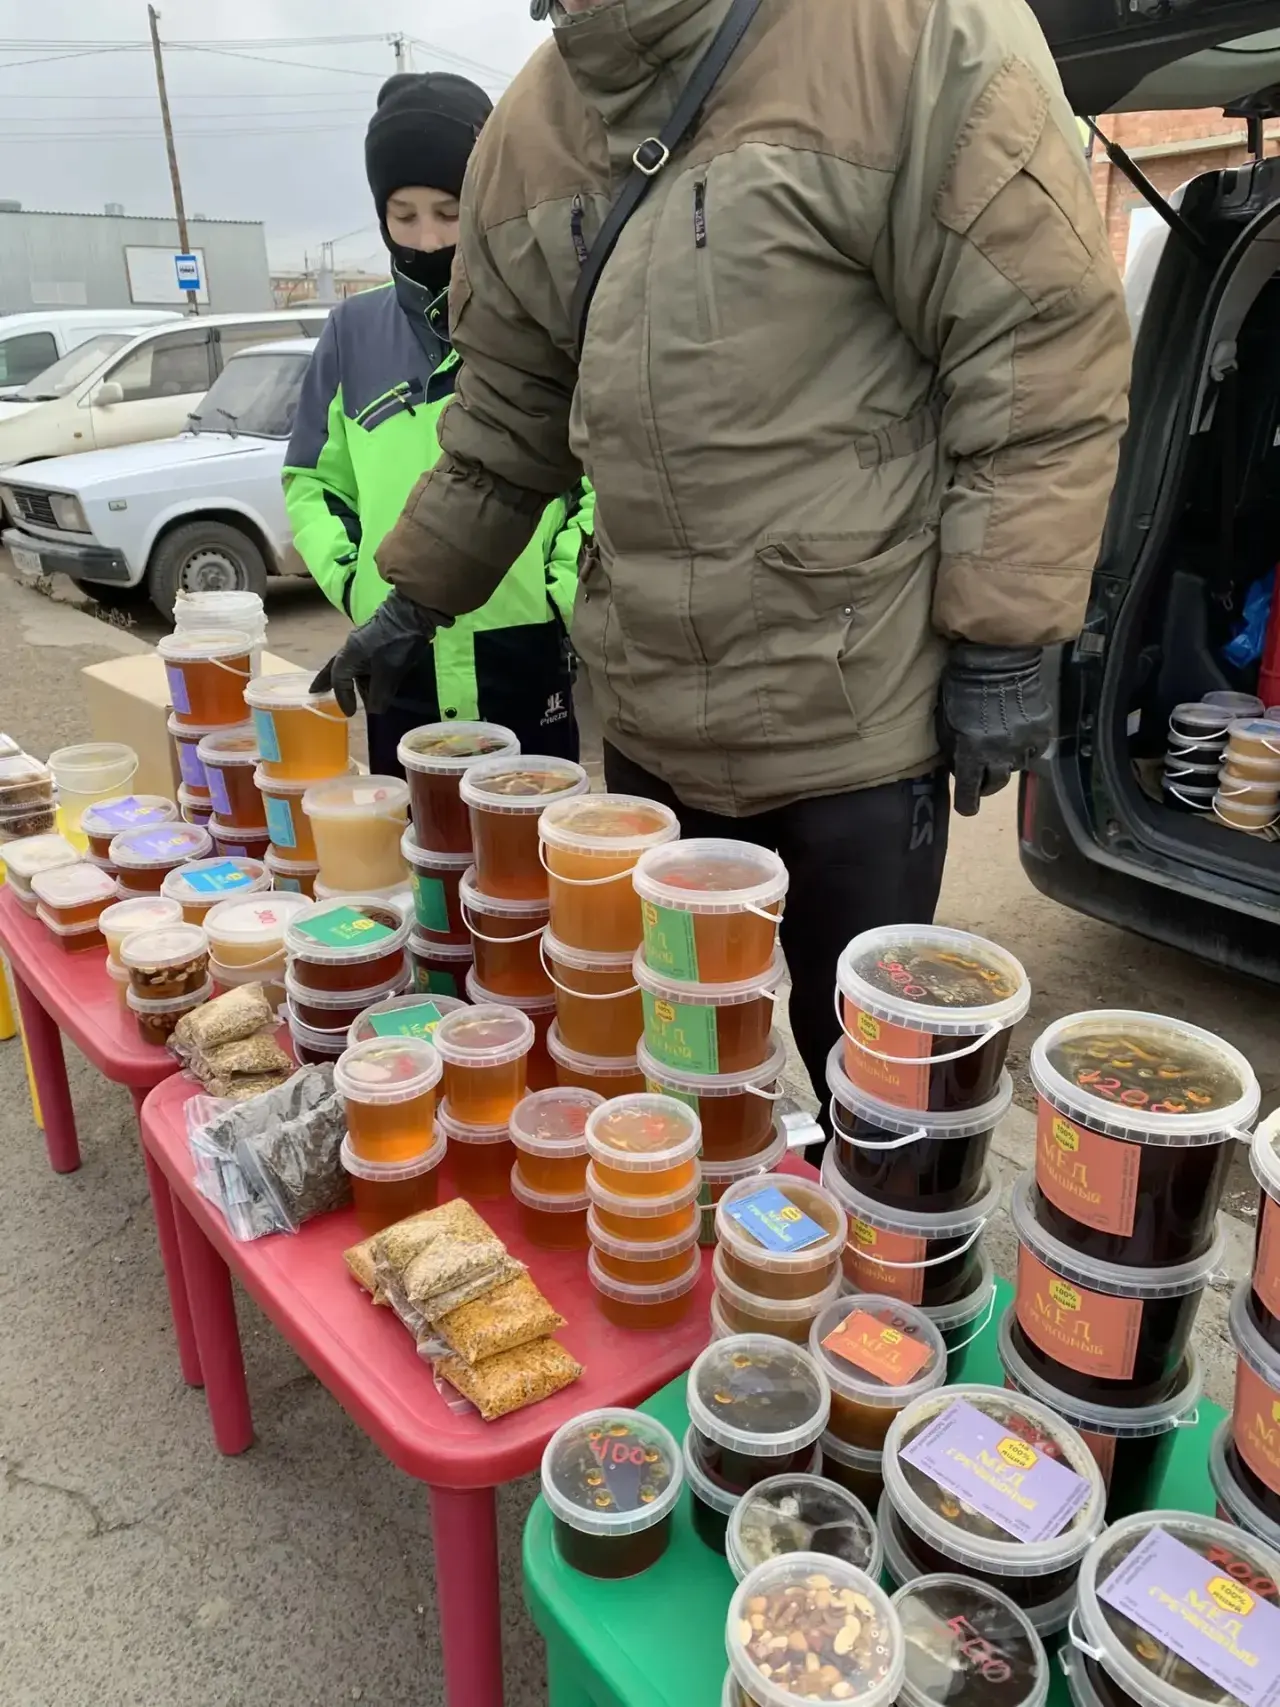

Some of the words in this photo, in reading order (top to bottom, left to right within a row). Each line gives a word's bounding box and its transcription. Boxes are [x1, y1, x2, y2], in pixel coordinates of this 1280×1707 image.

[1056, 1124, 1076, 1143] 100%
[1042, 1132, 1089, 1188] МЕД
[1054, 1285, 1078, 1303] 100%
[1035, 1292, 1091, 1342] МЕД
[589, 1436, 648, 1466] 400
[1008, 1443, 1032, 1461] 100%
[977, 1449, 1026, 1488] МЕД
[1220, 1583, 1248, 1606] 100%
[1184, 1588, 1245, 1639] МЕД
